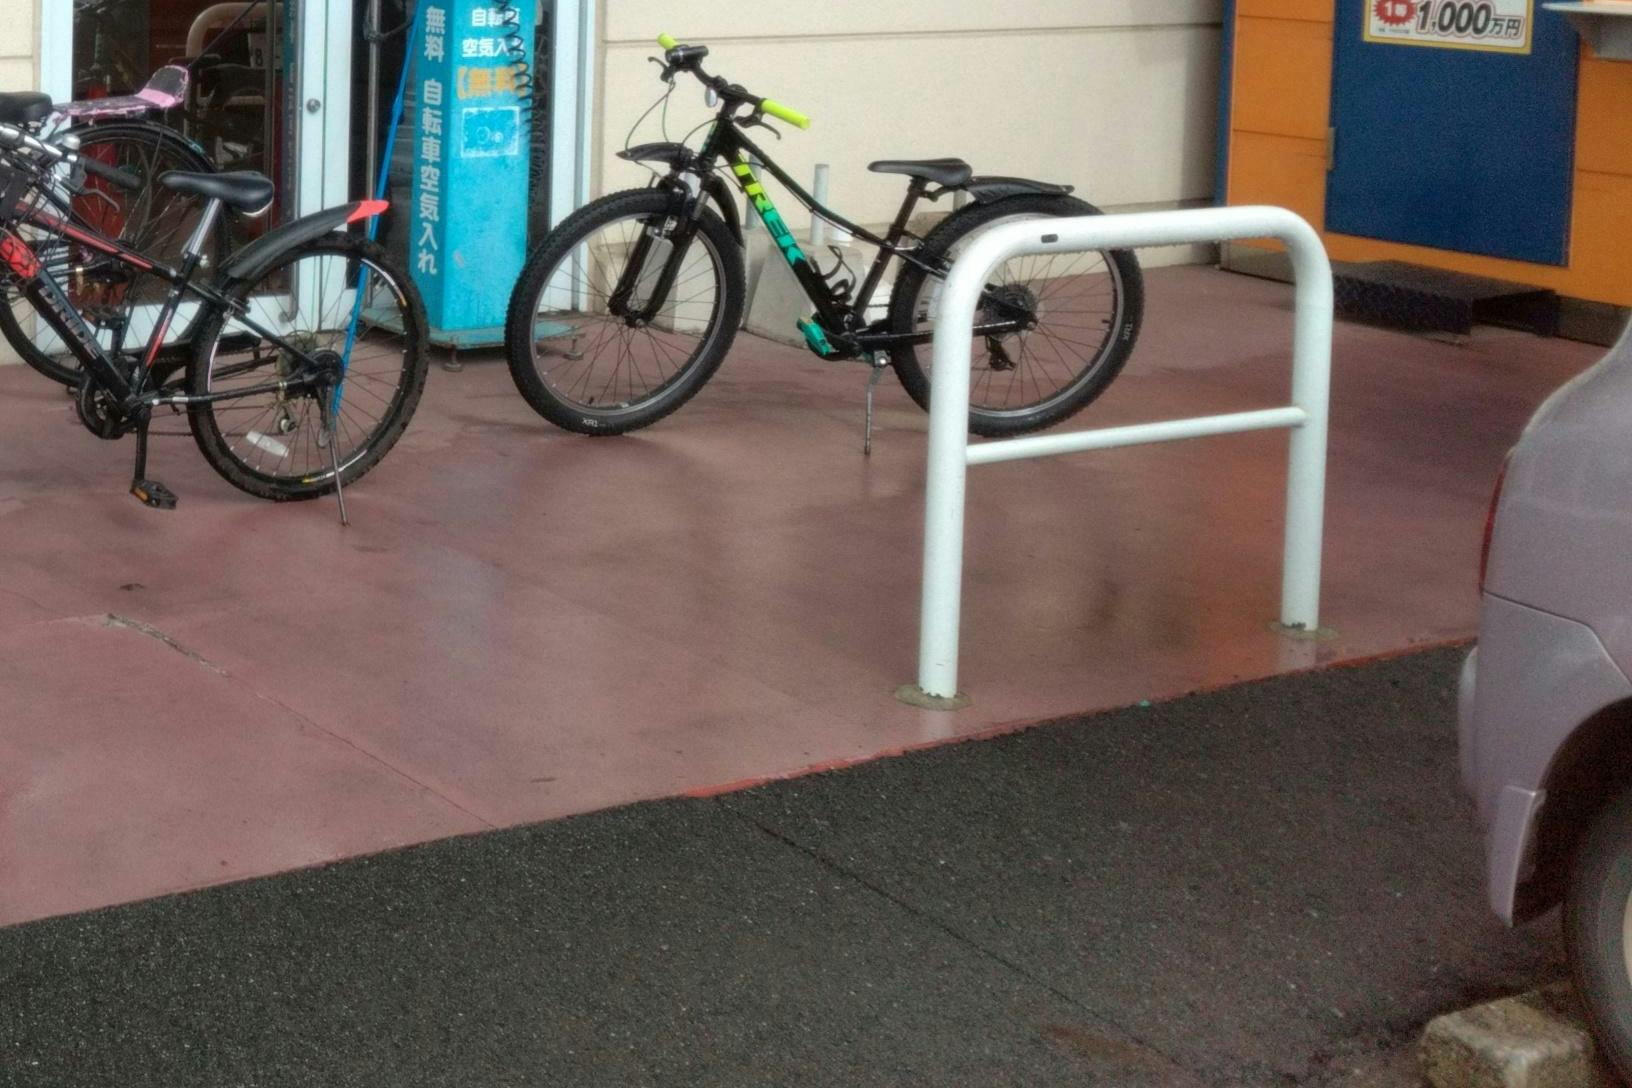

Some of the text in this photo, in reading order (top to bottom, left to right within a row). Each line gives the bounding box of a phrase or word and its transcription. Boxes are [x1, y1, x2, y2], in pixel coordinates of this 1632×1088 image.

[424, 6, 445, 63] 無料
[1419, 0, 1522, 37] 1,000万円
[418, 79, 443, 275] 自転車空気入れ
[732, 151, 806, 267] TREK
